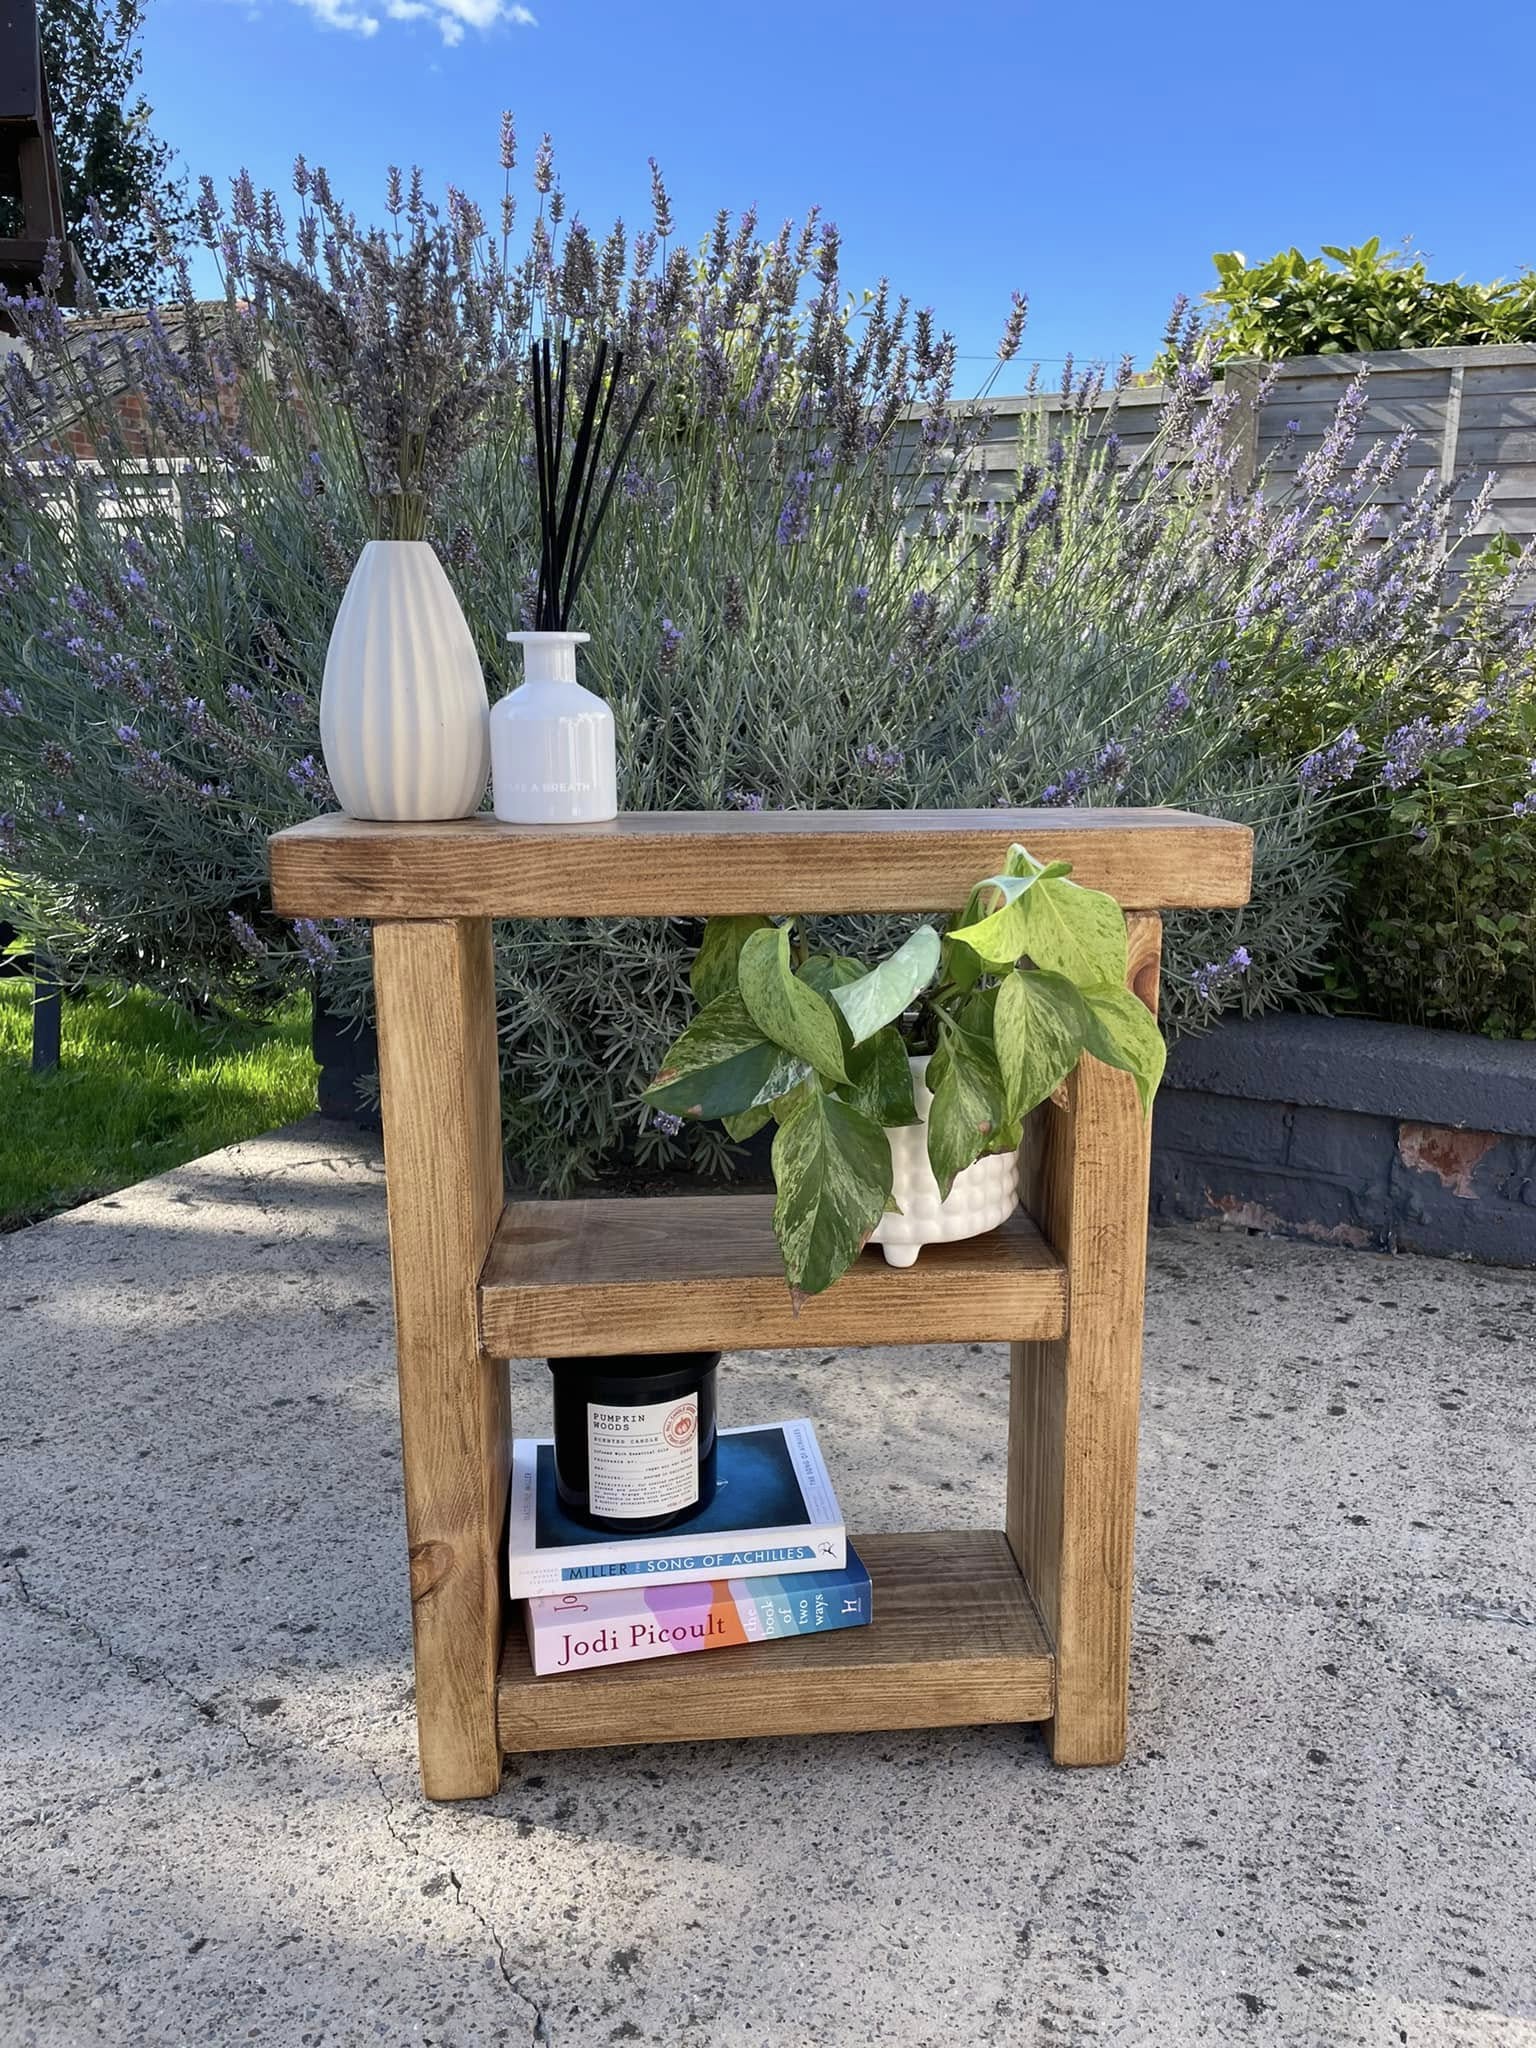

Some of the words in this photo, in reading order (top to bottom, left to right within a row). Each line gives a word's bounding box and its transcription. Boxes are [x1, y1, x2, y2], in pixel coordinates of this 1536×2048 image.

[542, 783, 591, 793] BREATH
[593, 1413, 646, 1423] PUMPKIN
[593, 1421, 631, 1432] WOODS
[569, 1563, 628, 1581] MILLER
[647, 1556, 695, 1572] SONG
[702, 1554, 724, 1567] OF
[731, 1547, 804, 1565] ACHILLES
[554, 1594, 589, 1612] Jo
[798, 1599, 809, 1625] two
[815, 1593, 829, 1626] ways
[744, 1608, 757, 1632] the
[760, 1600, 775, 1636] book
[778, 1607, 792, 1624] of
[557, 1629, 619, 1666] Jodi
[629, 1613, 727, 1648] Picoult
